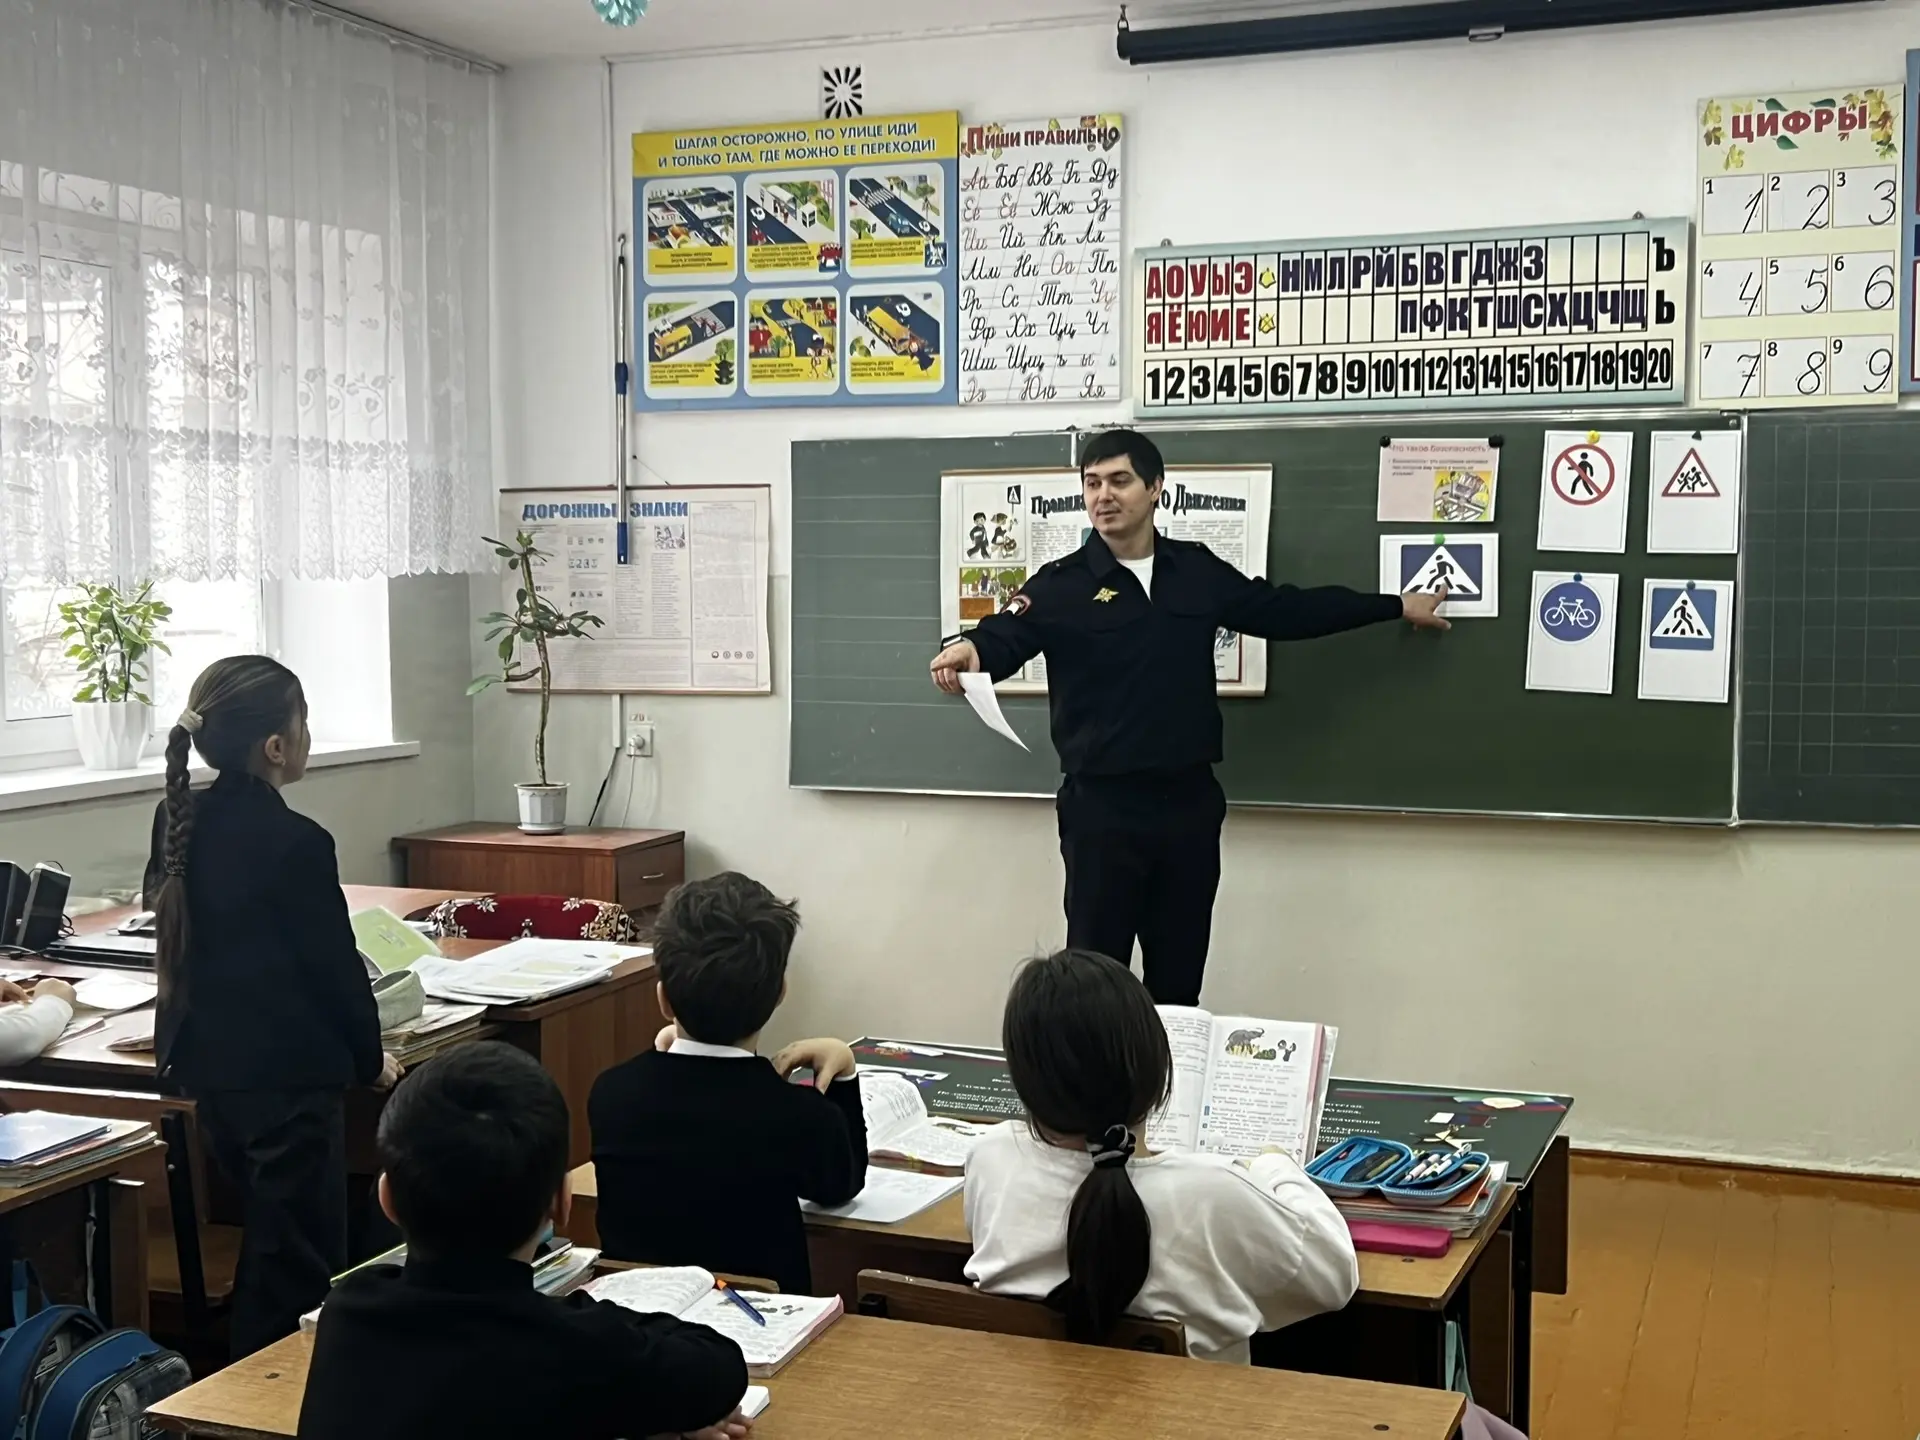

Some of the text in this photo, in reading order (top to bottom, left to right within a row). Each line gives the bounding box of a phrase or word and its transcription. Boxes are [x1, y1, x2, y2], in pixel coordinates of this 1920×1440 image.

[675, 122, 917, 150] ШАГАЯ ОСТОРОЖНО, ПО УЛИЦЕ ИДИ
[1732, 105, 1868, 143] ЦИФРЫ
[658, 139, 935, 168] И ТОЛЬКО ТАМ, ГДЕ МОЖНО ЕЕ ПЕРЕХОДИ!
[1706, 172, 1896, 233] 1 1 2 2 3 3
[962, 250, 1117, 281] Мм Нн Оо Пп
[1652, 237, 1675, 272] Ъ
[1704, 256, 1894, 316] 4 4 5 5 6 6
[1656, 290, 1675, 324] Ь
[1147, 347, 1671, 400] 1 2 3 4 5 6 7 8 9 10 11 12 13 14 15 16 17 18 19 20
[1703, 339, 1892, 397] 7 7 8 8 9 9
[1021, 375, 1057, 400] Юю
[1080, 374, 1105, 398] Яя
[522, 502, 688, 521] ДОРОЖНЫ ЗНАКИ
[1173, 483, 1246, 516] Движения
